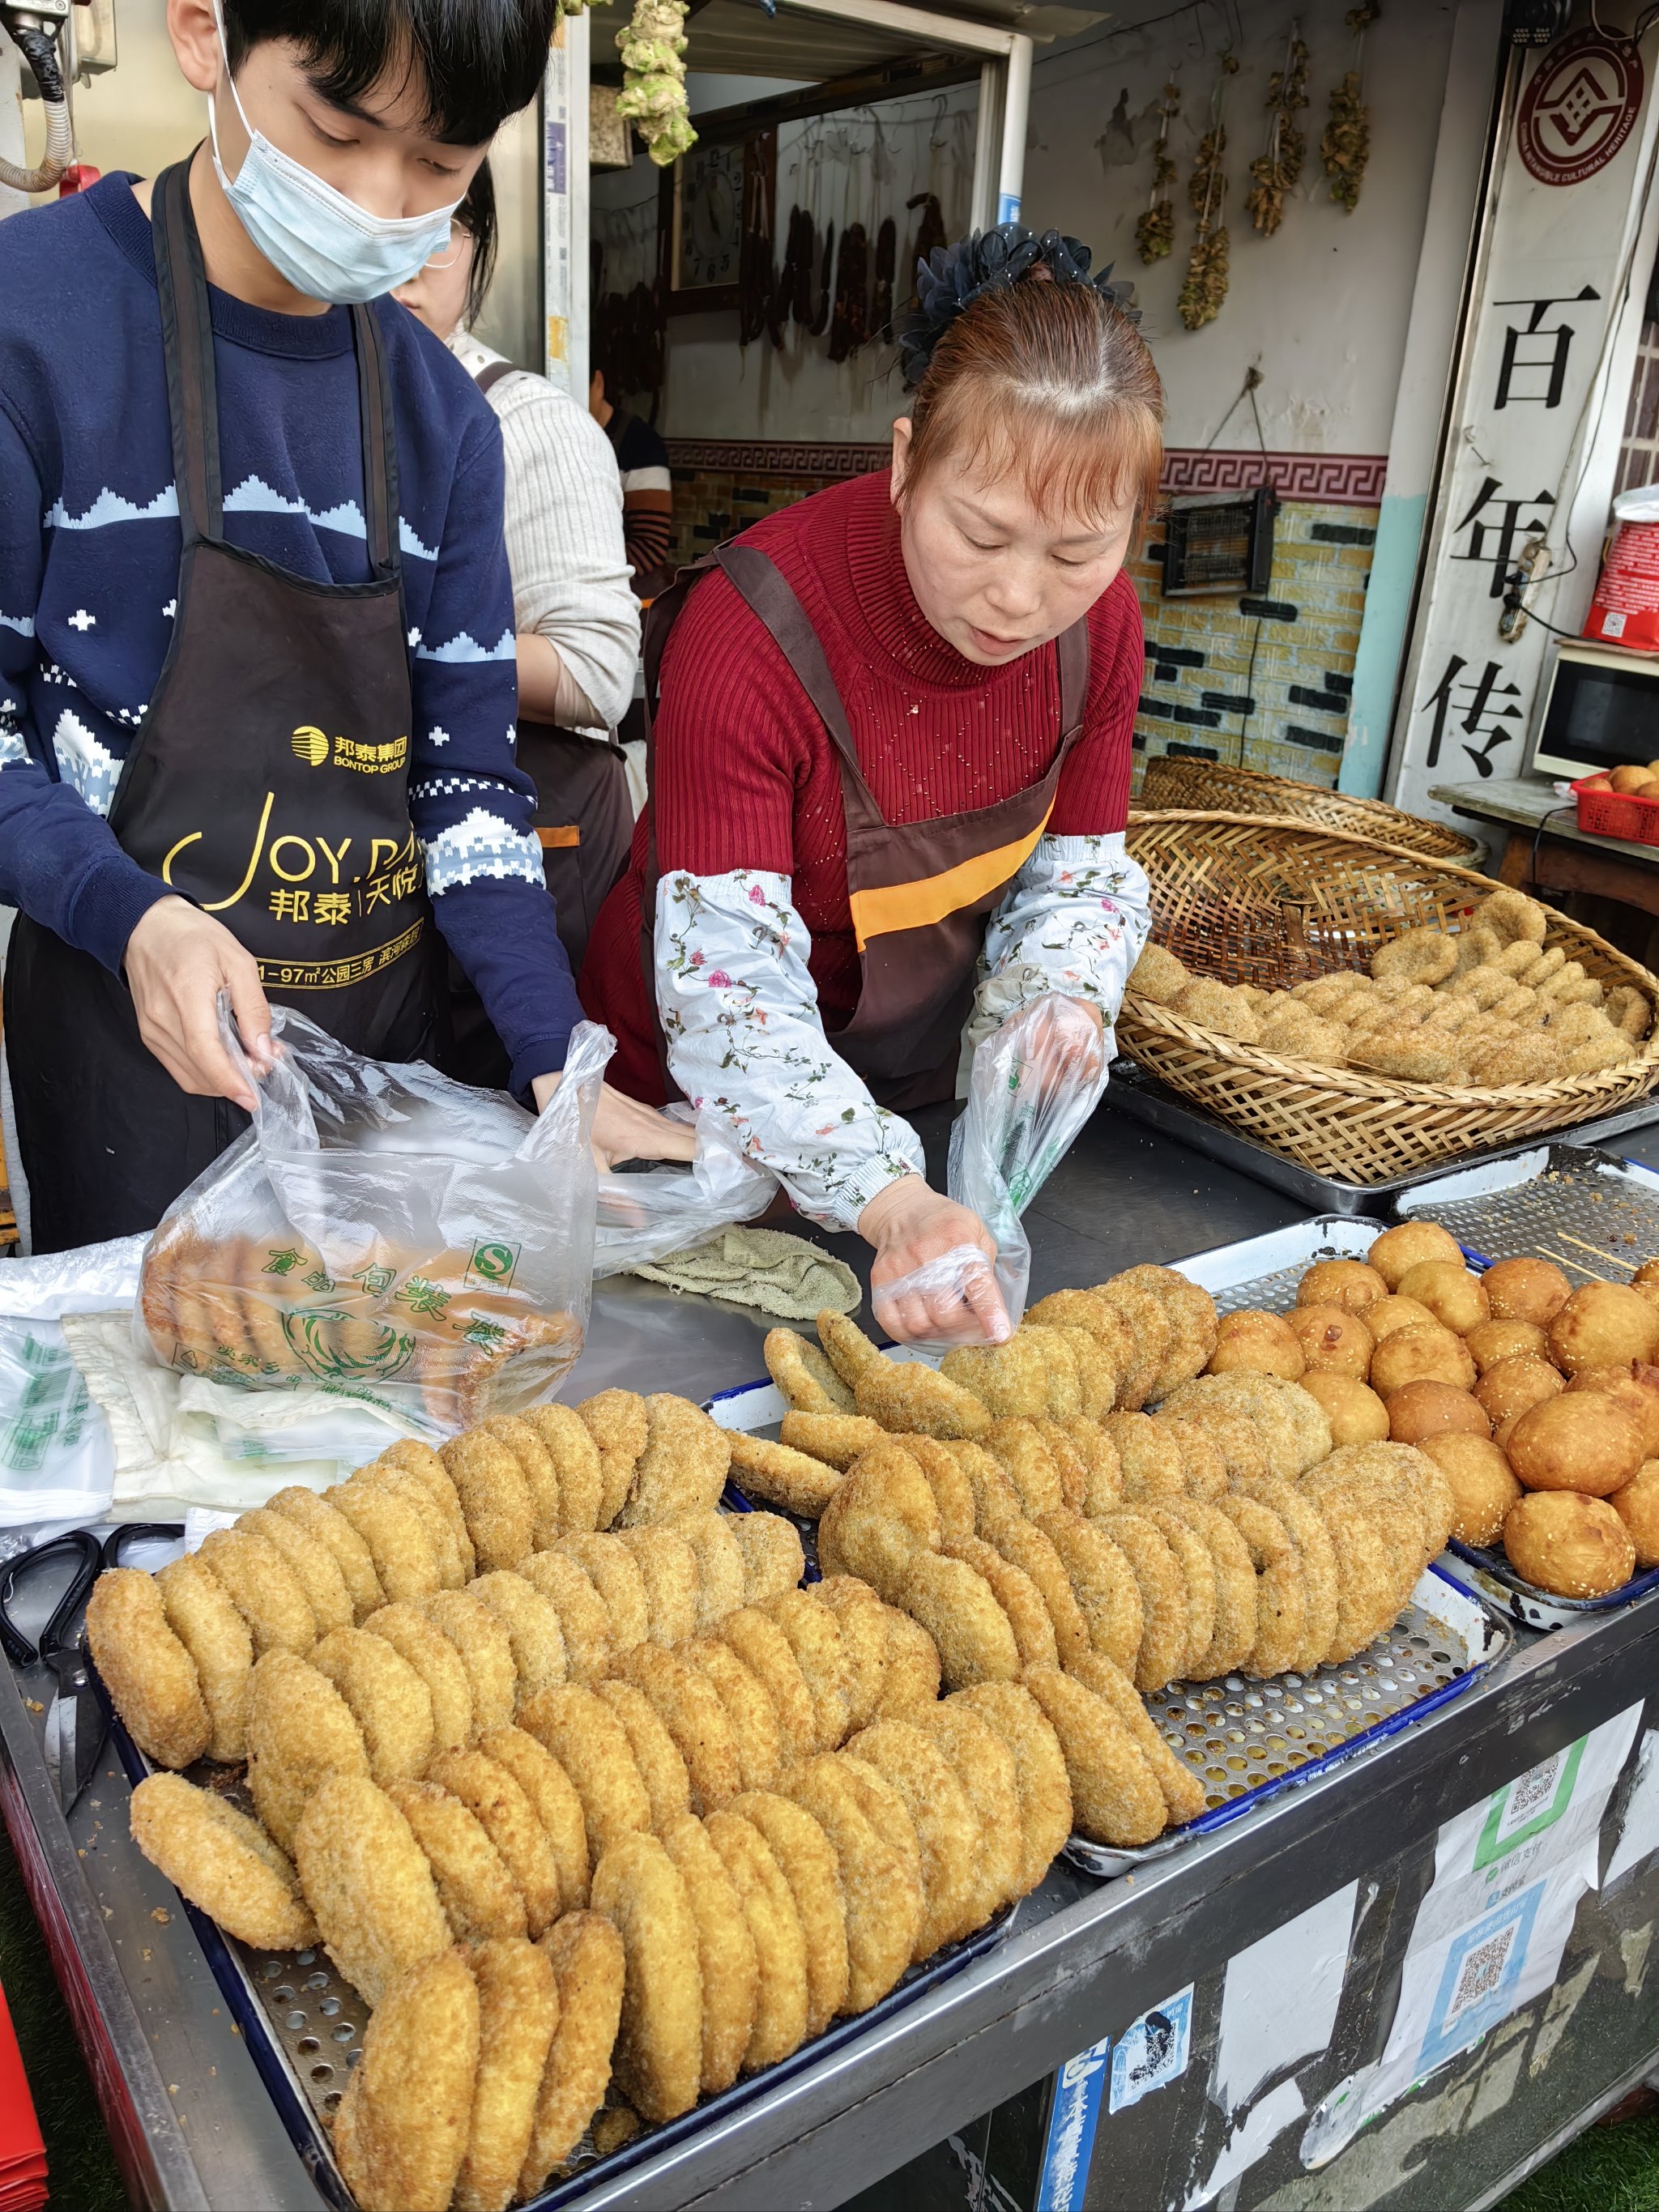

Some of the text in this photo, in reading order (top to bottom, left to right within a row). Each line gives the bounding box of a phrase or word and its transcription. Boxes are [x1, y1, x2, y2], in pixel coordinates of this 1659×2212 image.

[1605, 106, 1637, 157] HERITAGE
[335, 735, 407, 763] 邦泰集团
[334, 756, 406, 774] BONTOP GROUP
[269, 863, 422, 925] 邦泰 天悦
[1501, 1842, 1542, 1873] 微信支付
